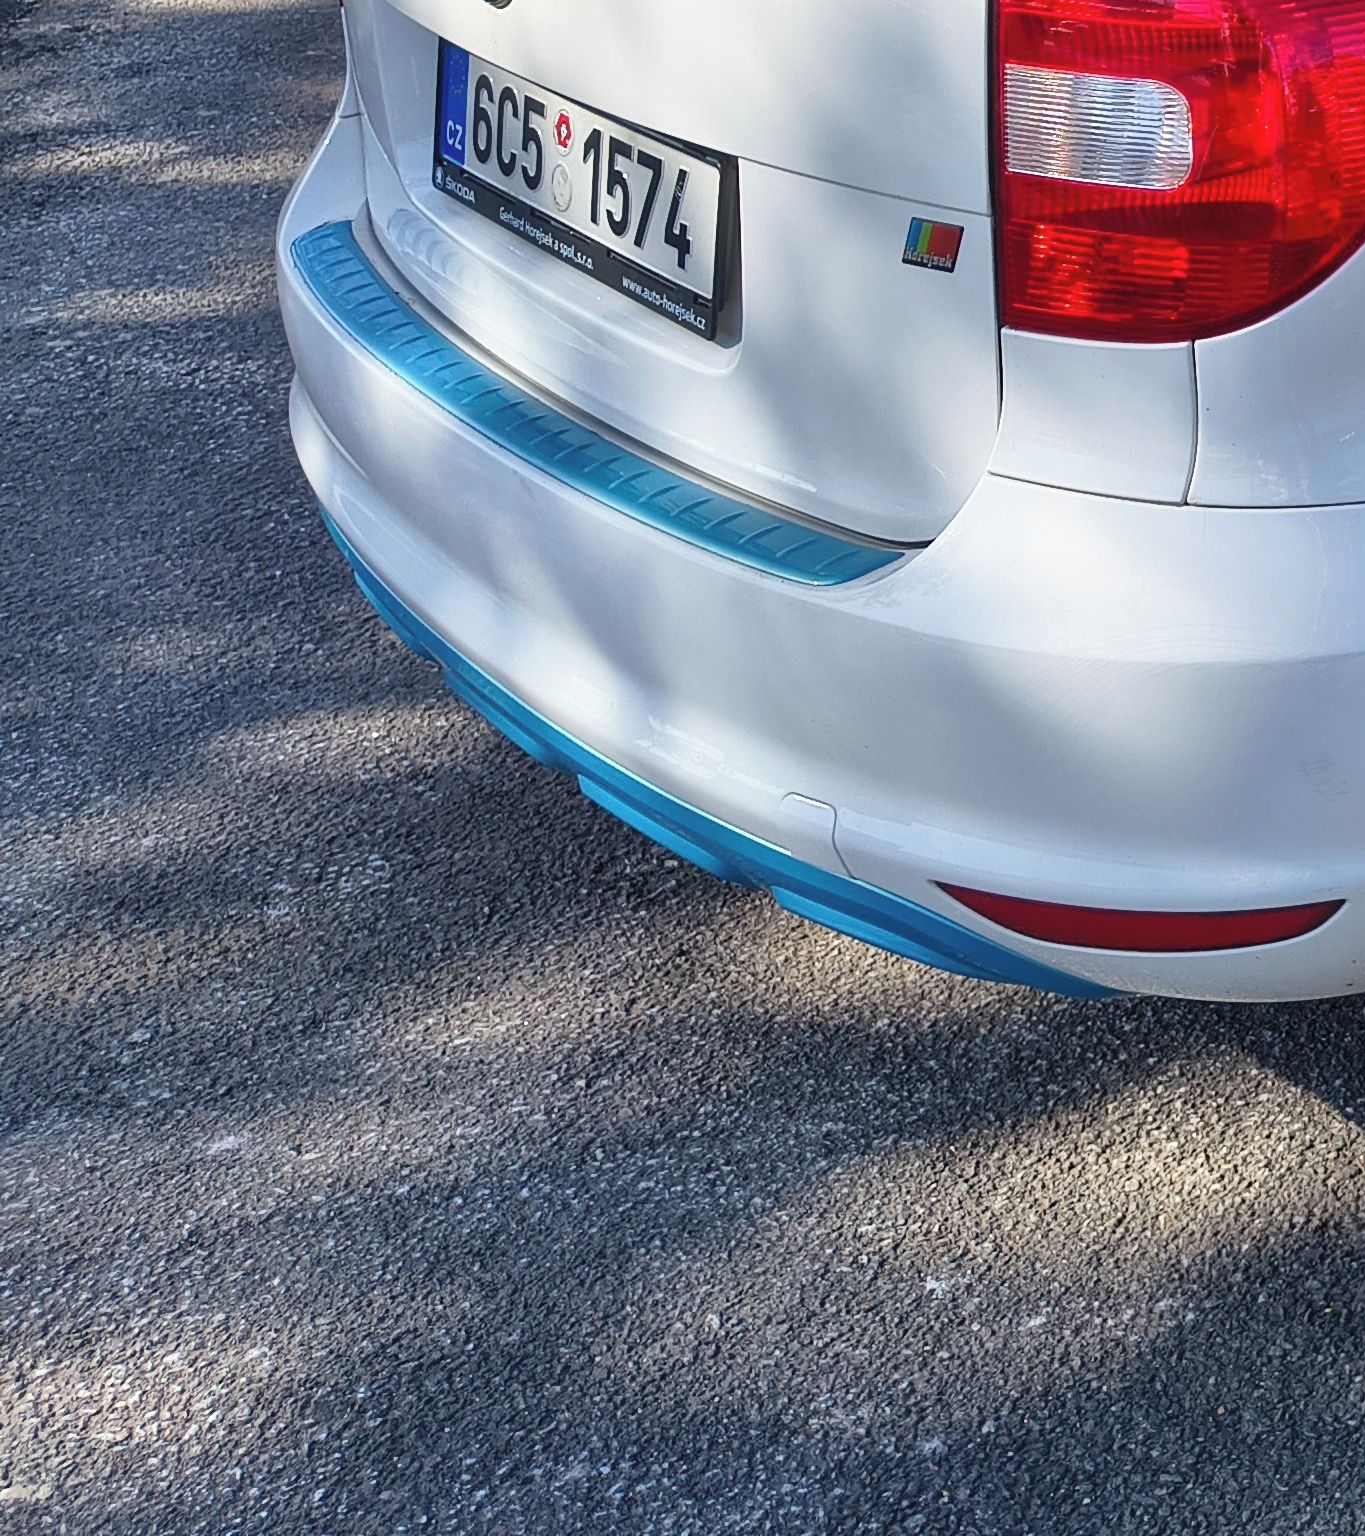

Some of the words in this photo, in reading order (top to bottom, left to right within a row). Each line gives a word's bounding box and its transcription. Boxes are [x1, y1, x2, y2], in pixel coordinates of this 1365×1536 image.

[446, 120, 463, 152] CZ
[445, 175, 476, 204] ŠKODA
[472, 73, 547, 191] 6C5
[582, 127, 692, 270] 1574
[499, 206, 525, 232] Gerhard
[553, 239, 559, 251] a
[622, 276, 707, 330] www.auto-horejsek.cz
